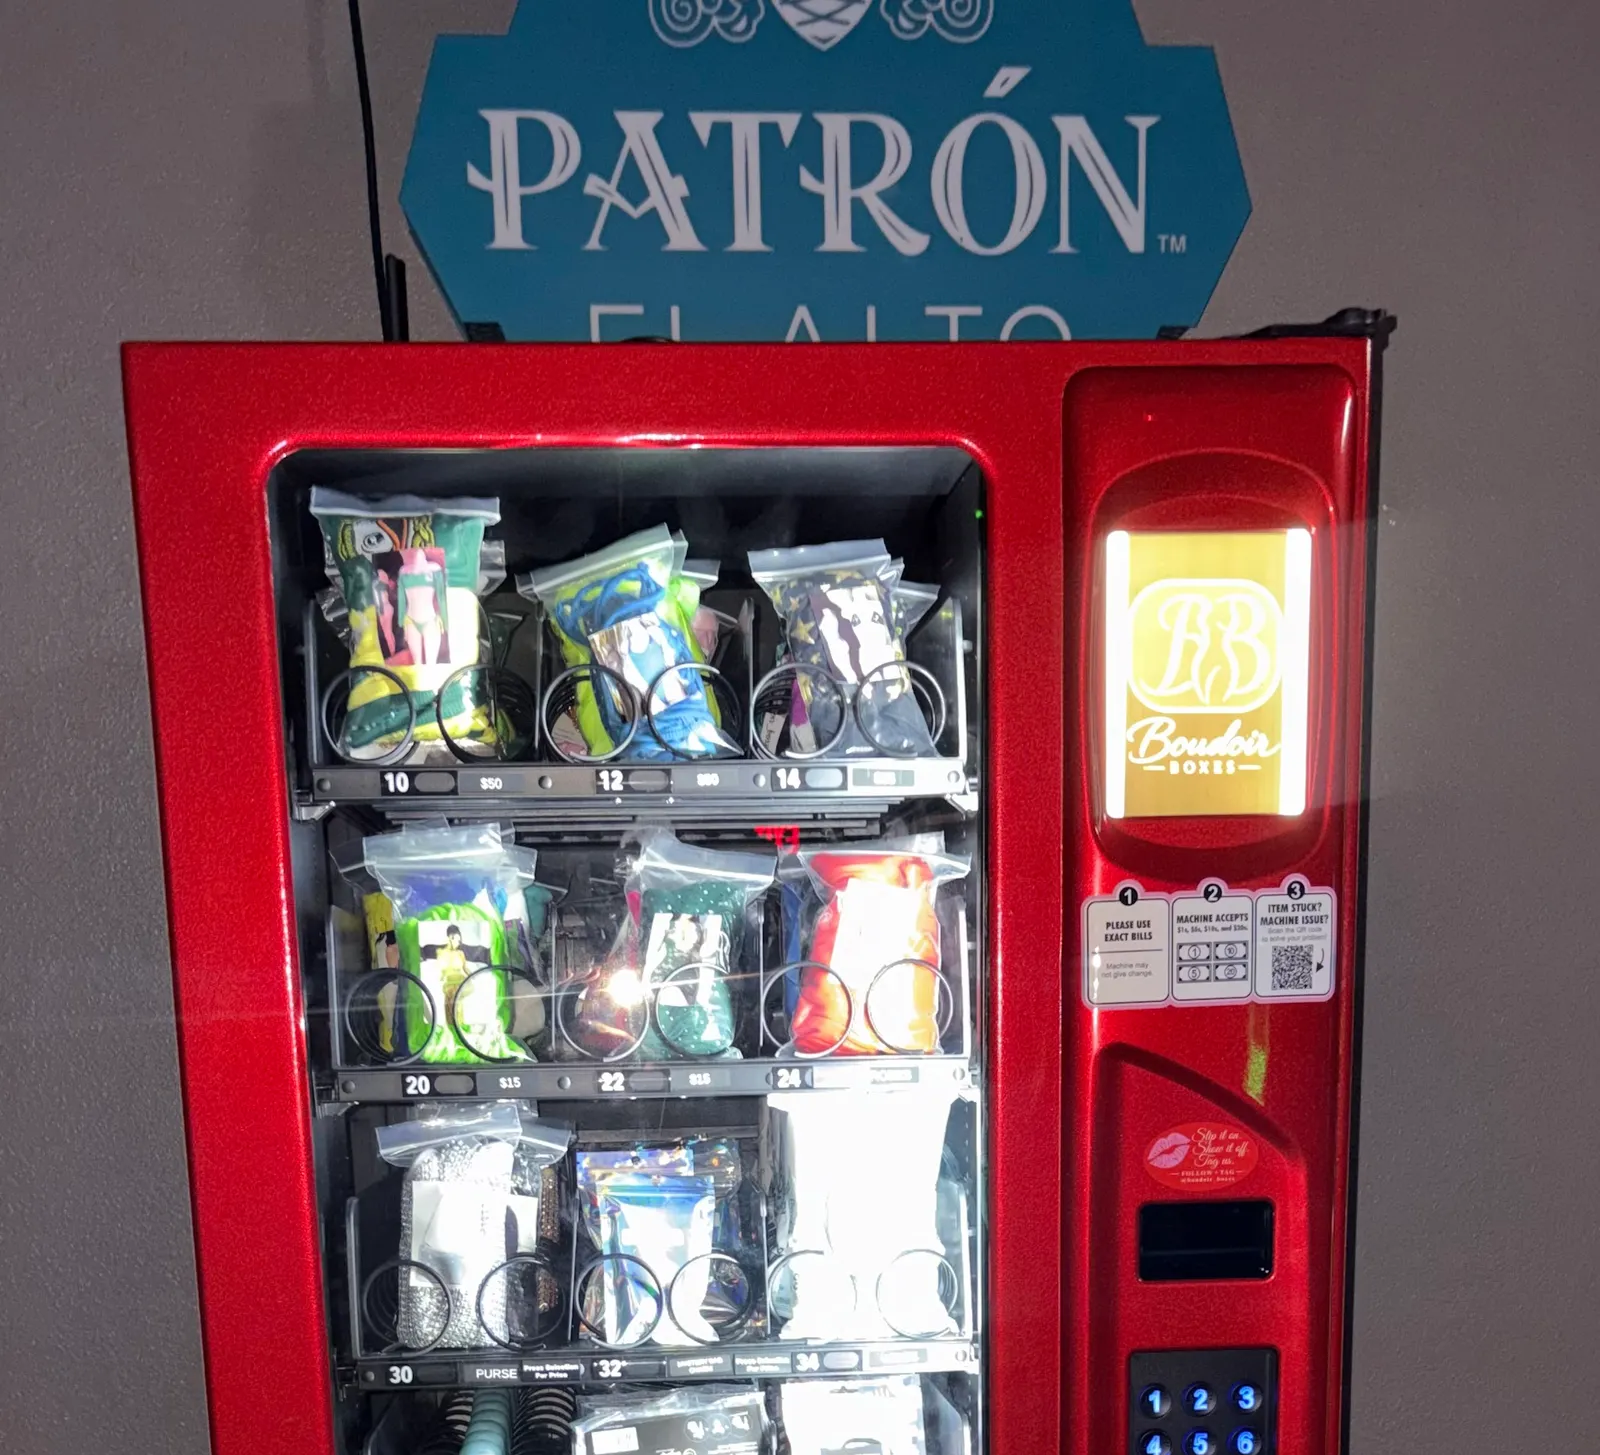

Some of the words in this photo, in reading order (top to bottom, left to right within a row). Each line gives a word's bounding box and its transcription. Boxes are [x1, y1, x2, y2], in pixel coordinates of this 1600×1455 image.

[466, 66, 1161, 258] PATRÓN
[1126, 715, 1282, 765] Boudoir
[1169, 759, 1236, 775] BOXES
[384, 771, 410, 794] 10
[479, 776, 503, 791] $50
[599, 769, 623, 792] 12
[776, 767, 801, 789] 14
[1123, 887, 1133, 905] 1
[1207, 886, 1219, 901] 2
[1290, 882, 1302, 899] 3
[1267, 903, 1289, 913] ITEM
[1291, 902, 1323, 913] STUCK?
[1105, 920, 1134, 930] PLEASE
[1136, 919, 1151, 929] USE
[1176, 914, 1213, 924] MACHINE
[1215, 912, 1249, 923] ACCEPTS
[1260, 915, 1299, 926] MACHINE
[1301, 914, 1329, 925] ISSUE?
[1104, 932, 1129, 942] EXACT
[1131, 931, 1153, 941] BILLS
[1101, 971, 1112, 979] not
[1113, 970, 1127, 979] give
[1106, 962, 1134, 970] Machine
[1135, 962, 1149, 970] may
[405, 1074, 431, 1095] 20
[499, 1076, 521, 1090] $15
[600, 1071, 625, 1093] 22
[776, 1067, 801, 1088] 24
[598, 1359, 623, 1378] 32
[796, 1352, 820, 1373] 34
[388, 1365, 414, 1385] 30
[475, 1368, 518, 1381] PURSE
[1149, 1389, 1161, 1413] 1
[1193, 1388, 1209, 1411] 2
[1238, 1385, 1255, 1410] 3
[1193, 1432, 1209, 1455] 5
[1237, 1431, 1254, 1455] 6
